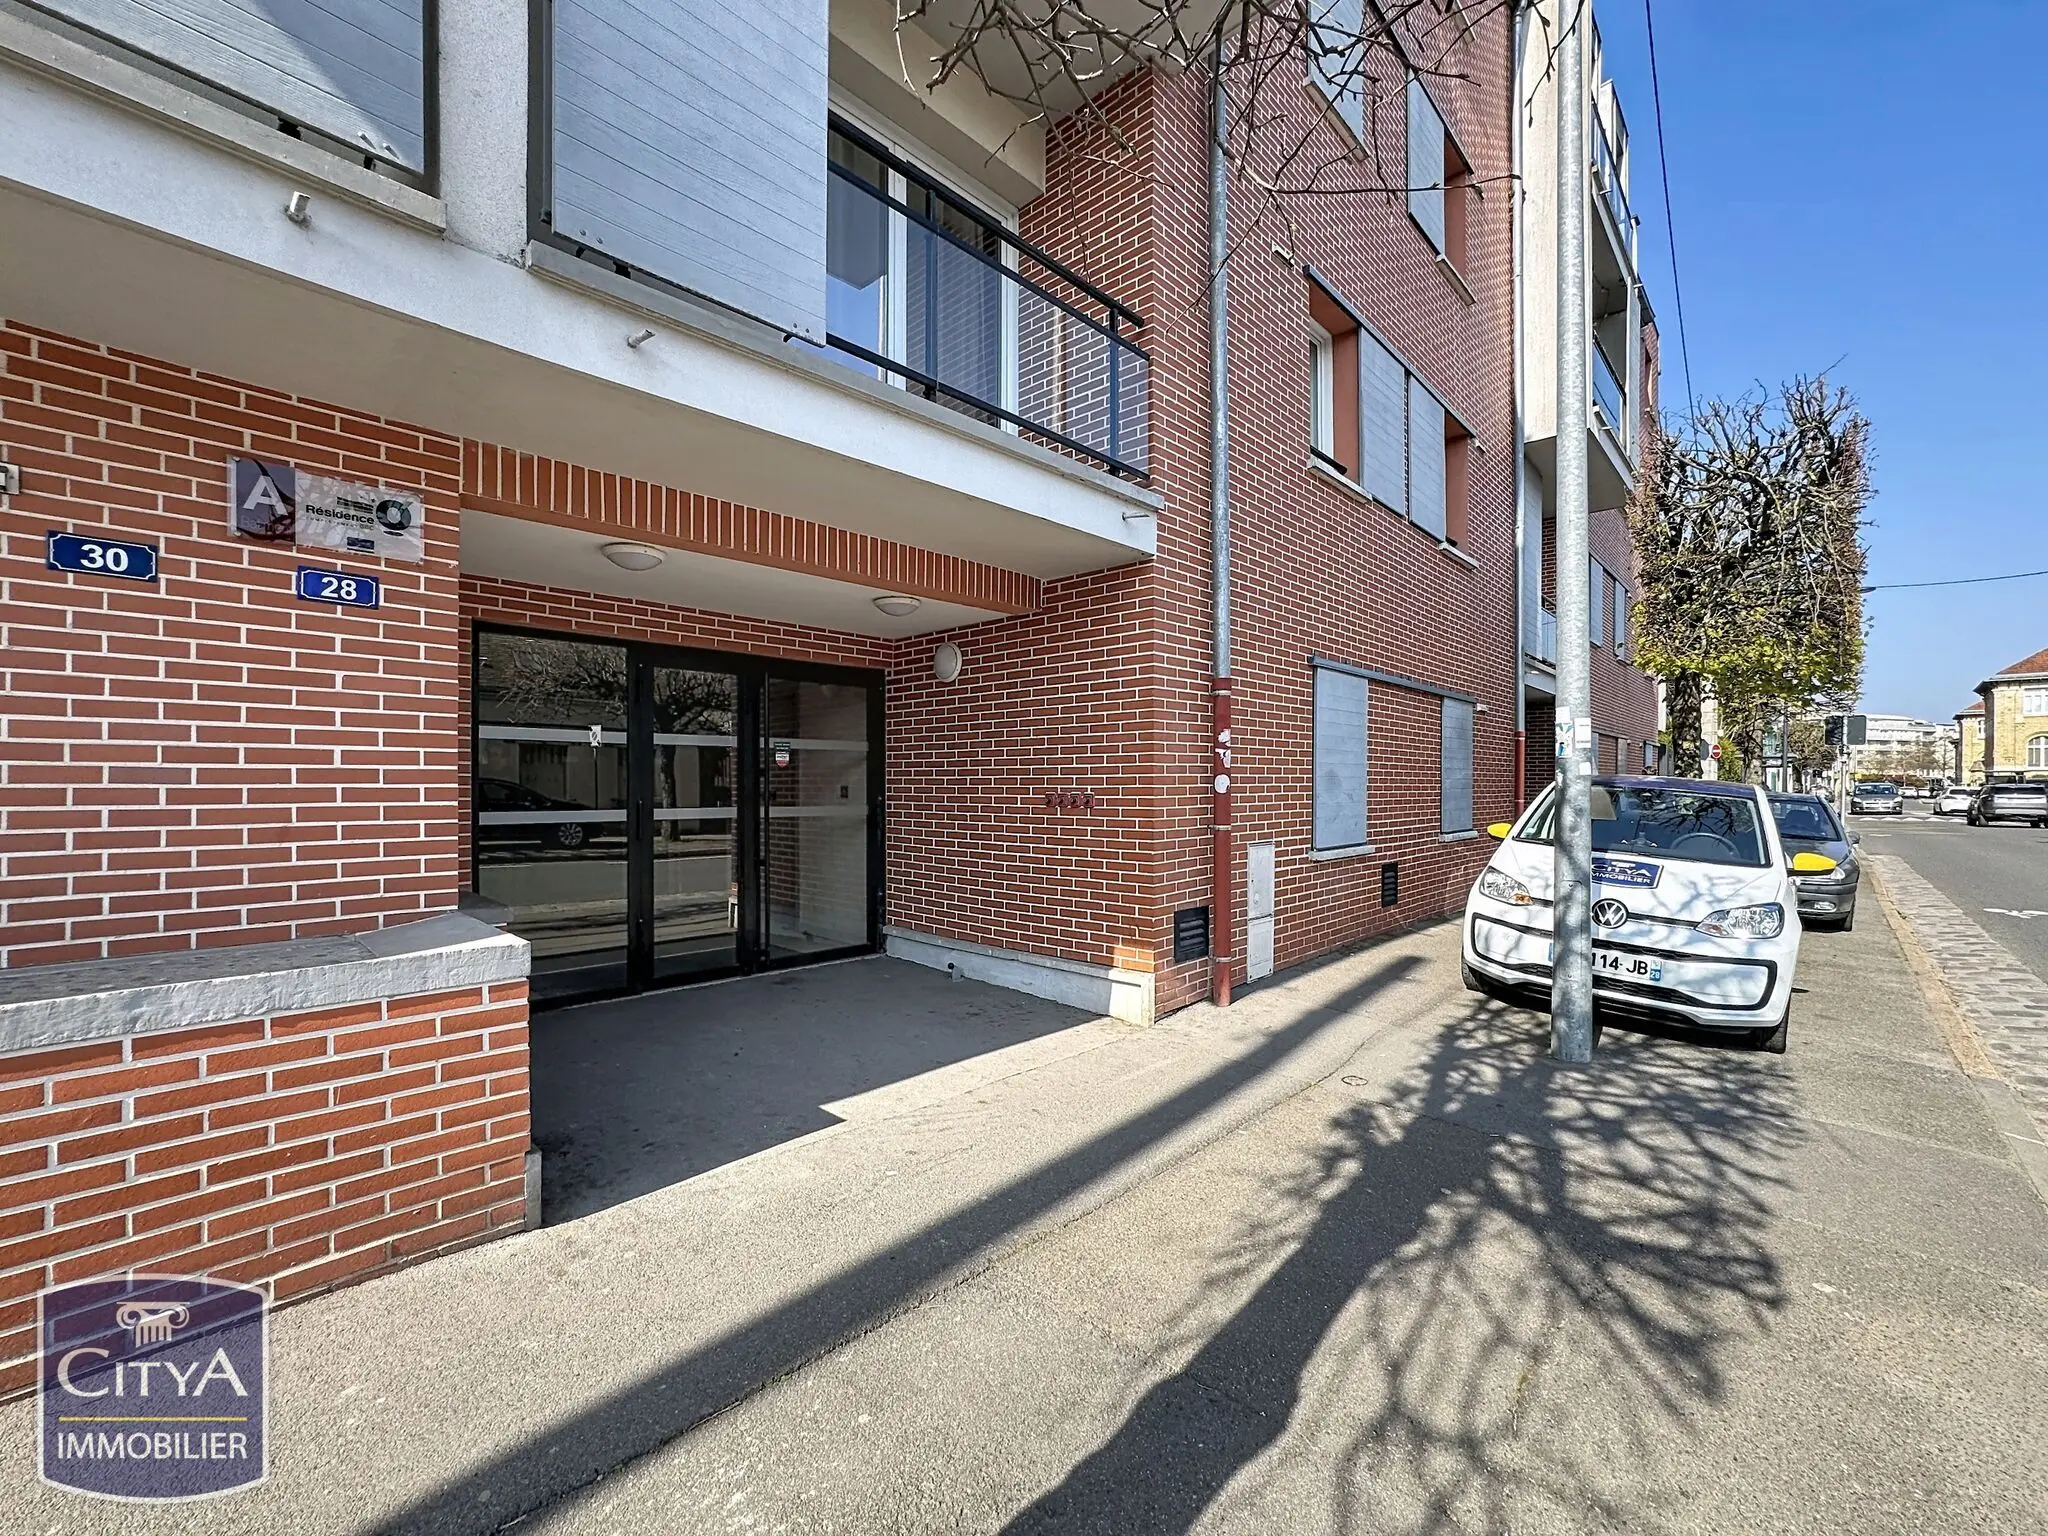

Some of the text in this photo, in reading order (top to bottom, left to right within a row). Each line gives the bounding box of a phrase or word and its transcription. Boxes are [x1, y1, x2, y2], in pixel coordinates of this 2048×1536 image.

[304, 504, 376, 526] Résidence
[80, 543, 129, 572] 30
[320, 576, 358, 600] 28
[1590, 871, 1651, 884] MMOBILIER
